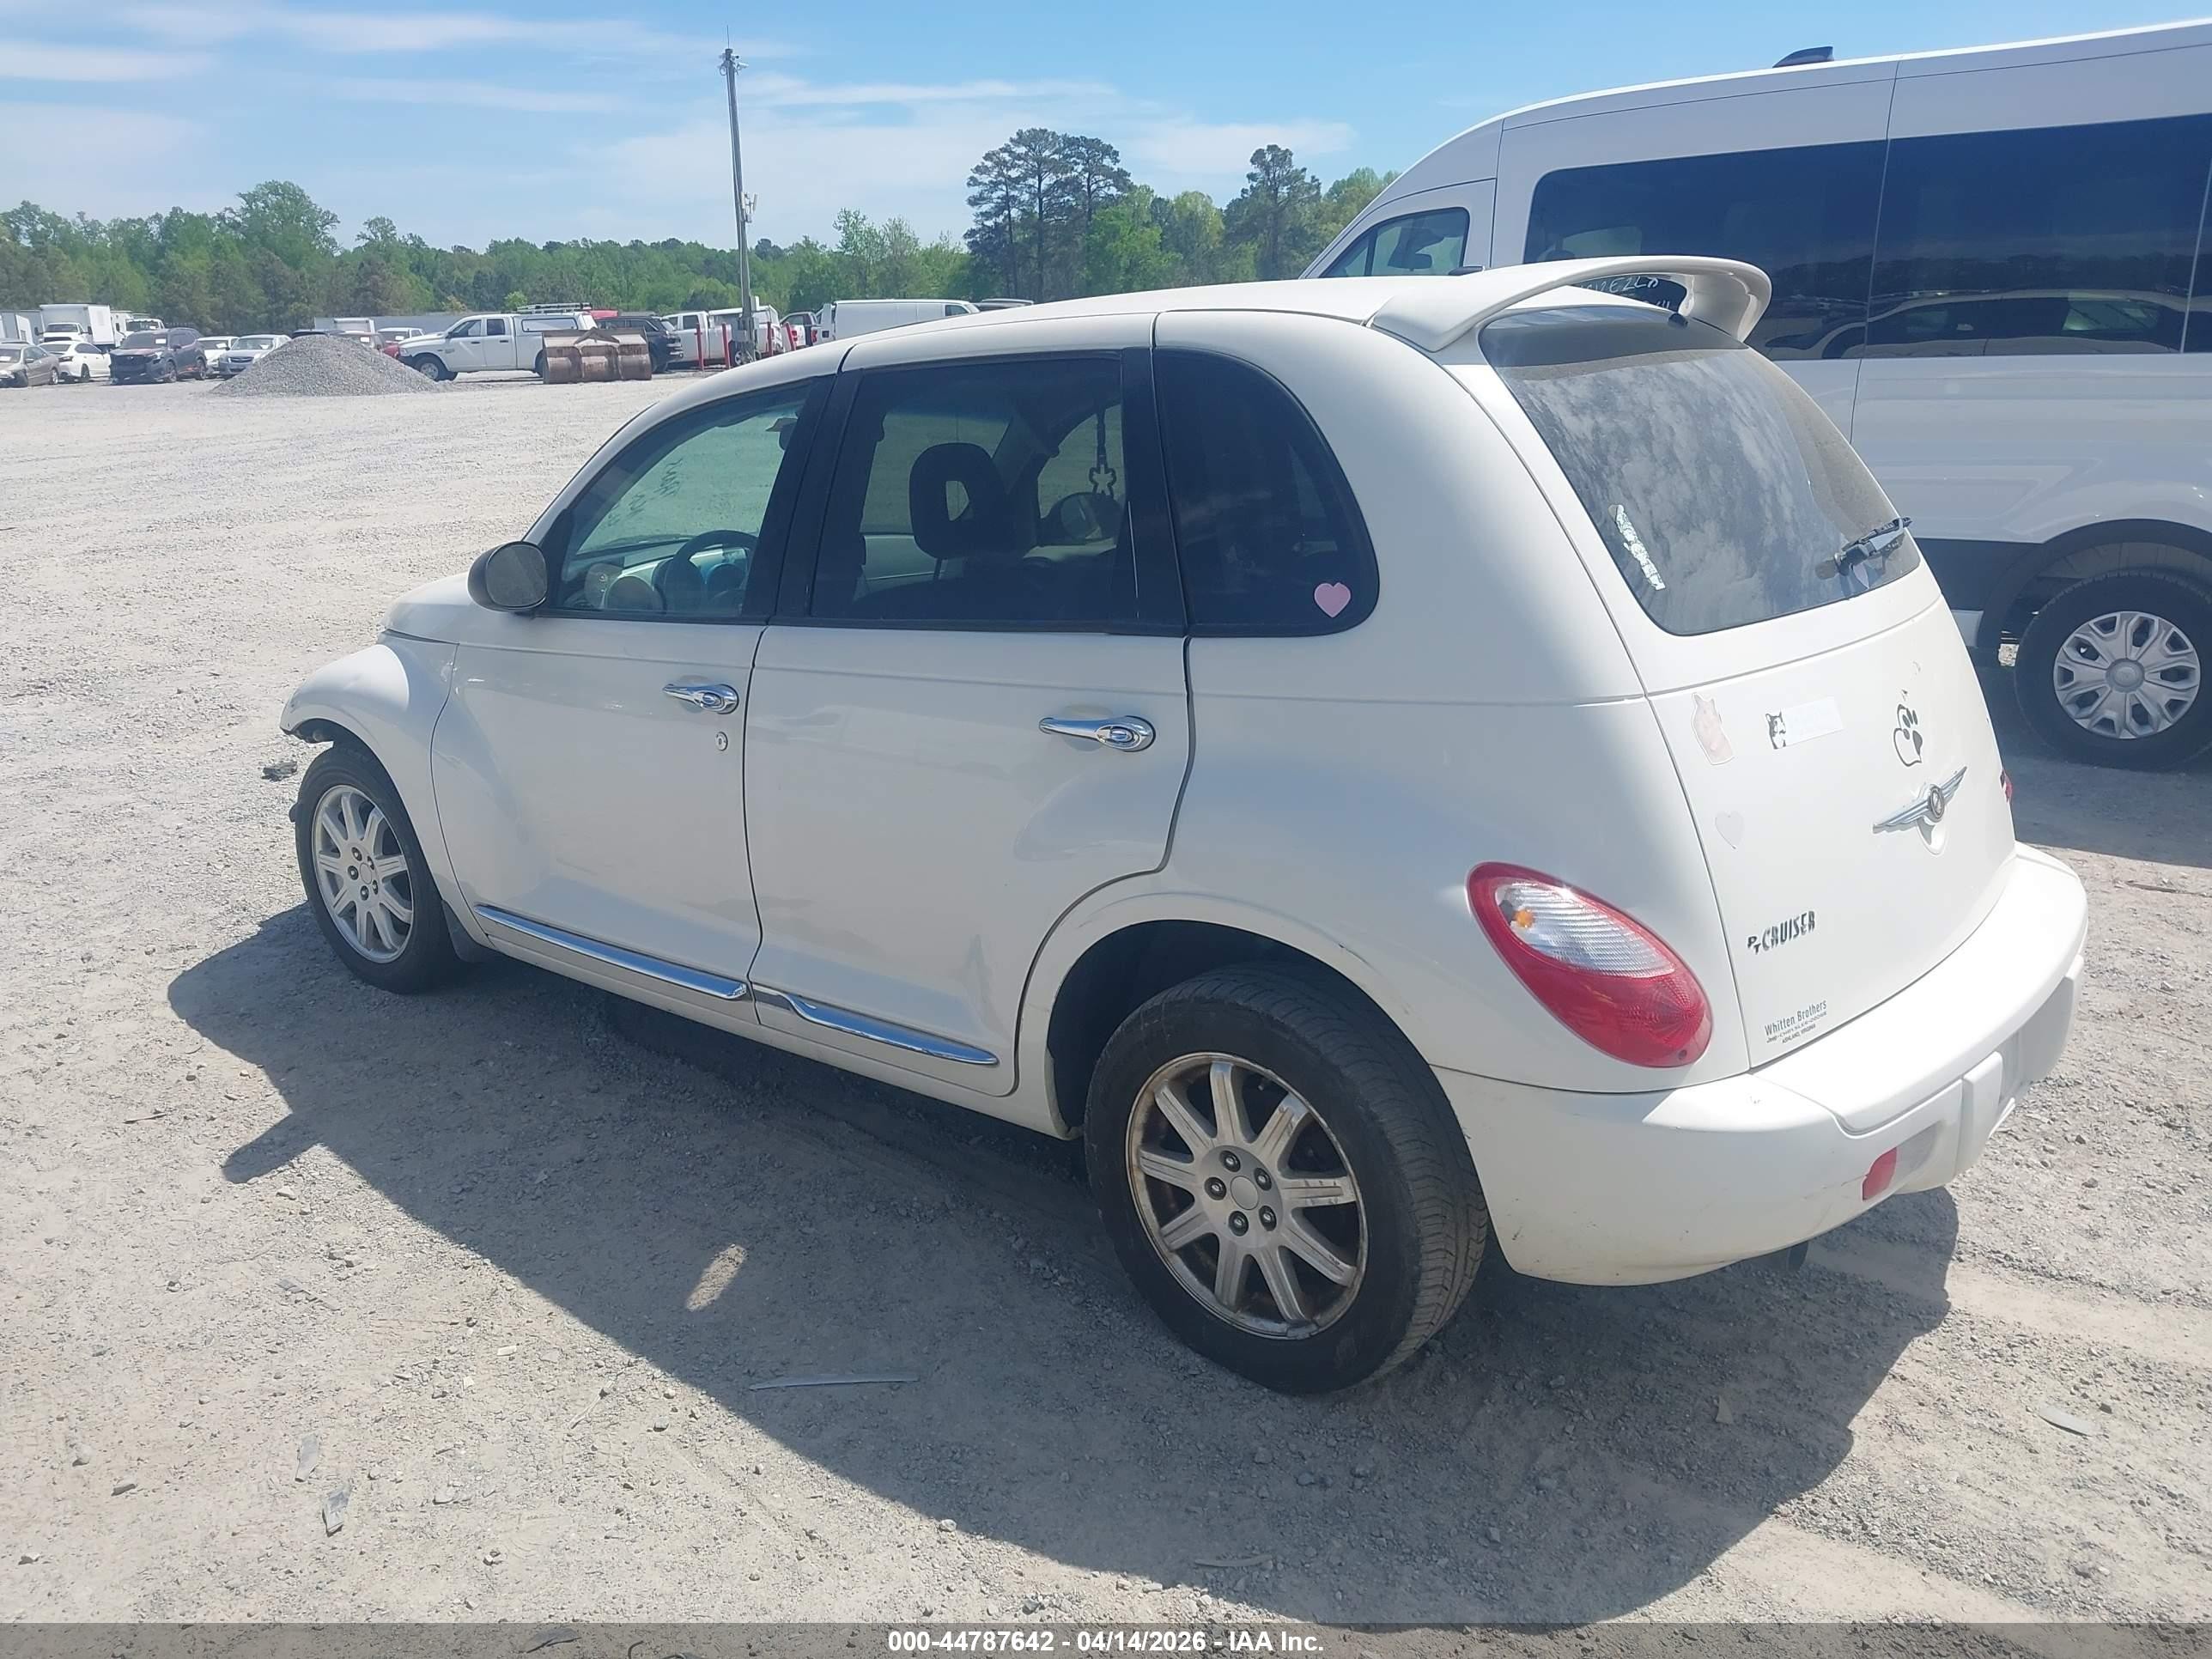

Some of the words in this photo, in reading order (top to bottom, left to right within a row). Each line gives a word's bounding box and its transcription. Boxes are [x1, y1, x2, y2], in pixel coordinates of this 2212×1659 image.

[1747, 934, 1761, 955] PT
[1761, 910, 1815, 951] CRUISER
[1764, 1015, 1796, 1036] Whitten
[1796, 1000, 1827, 1022] Brothers
